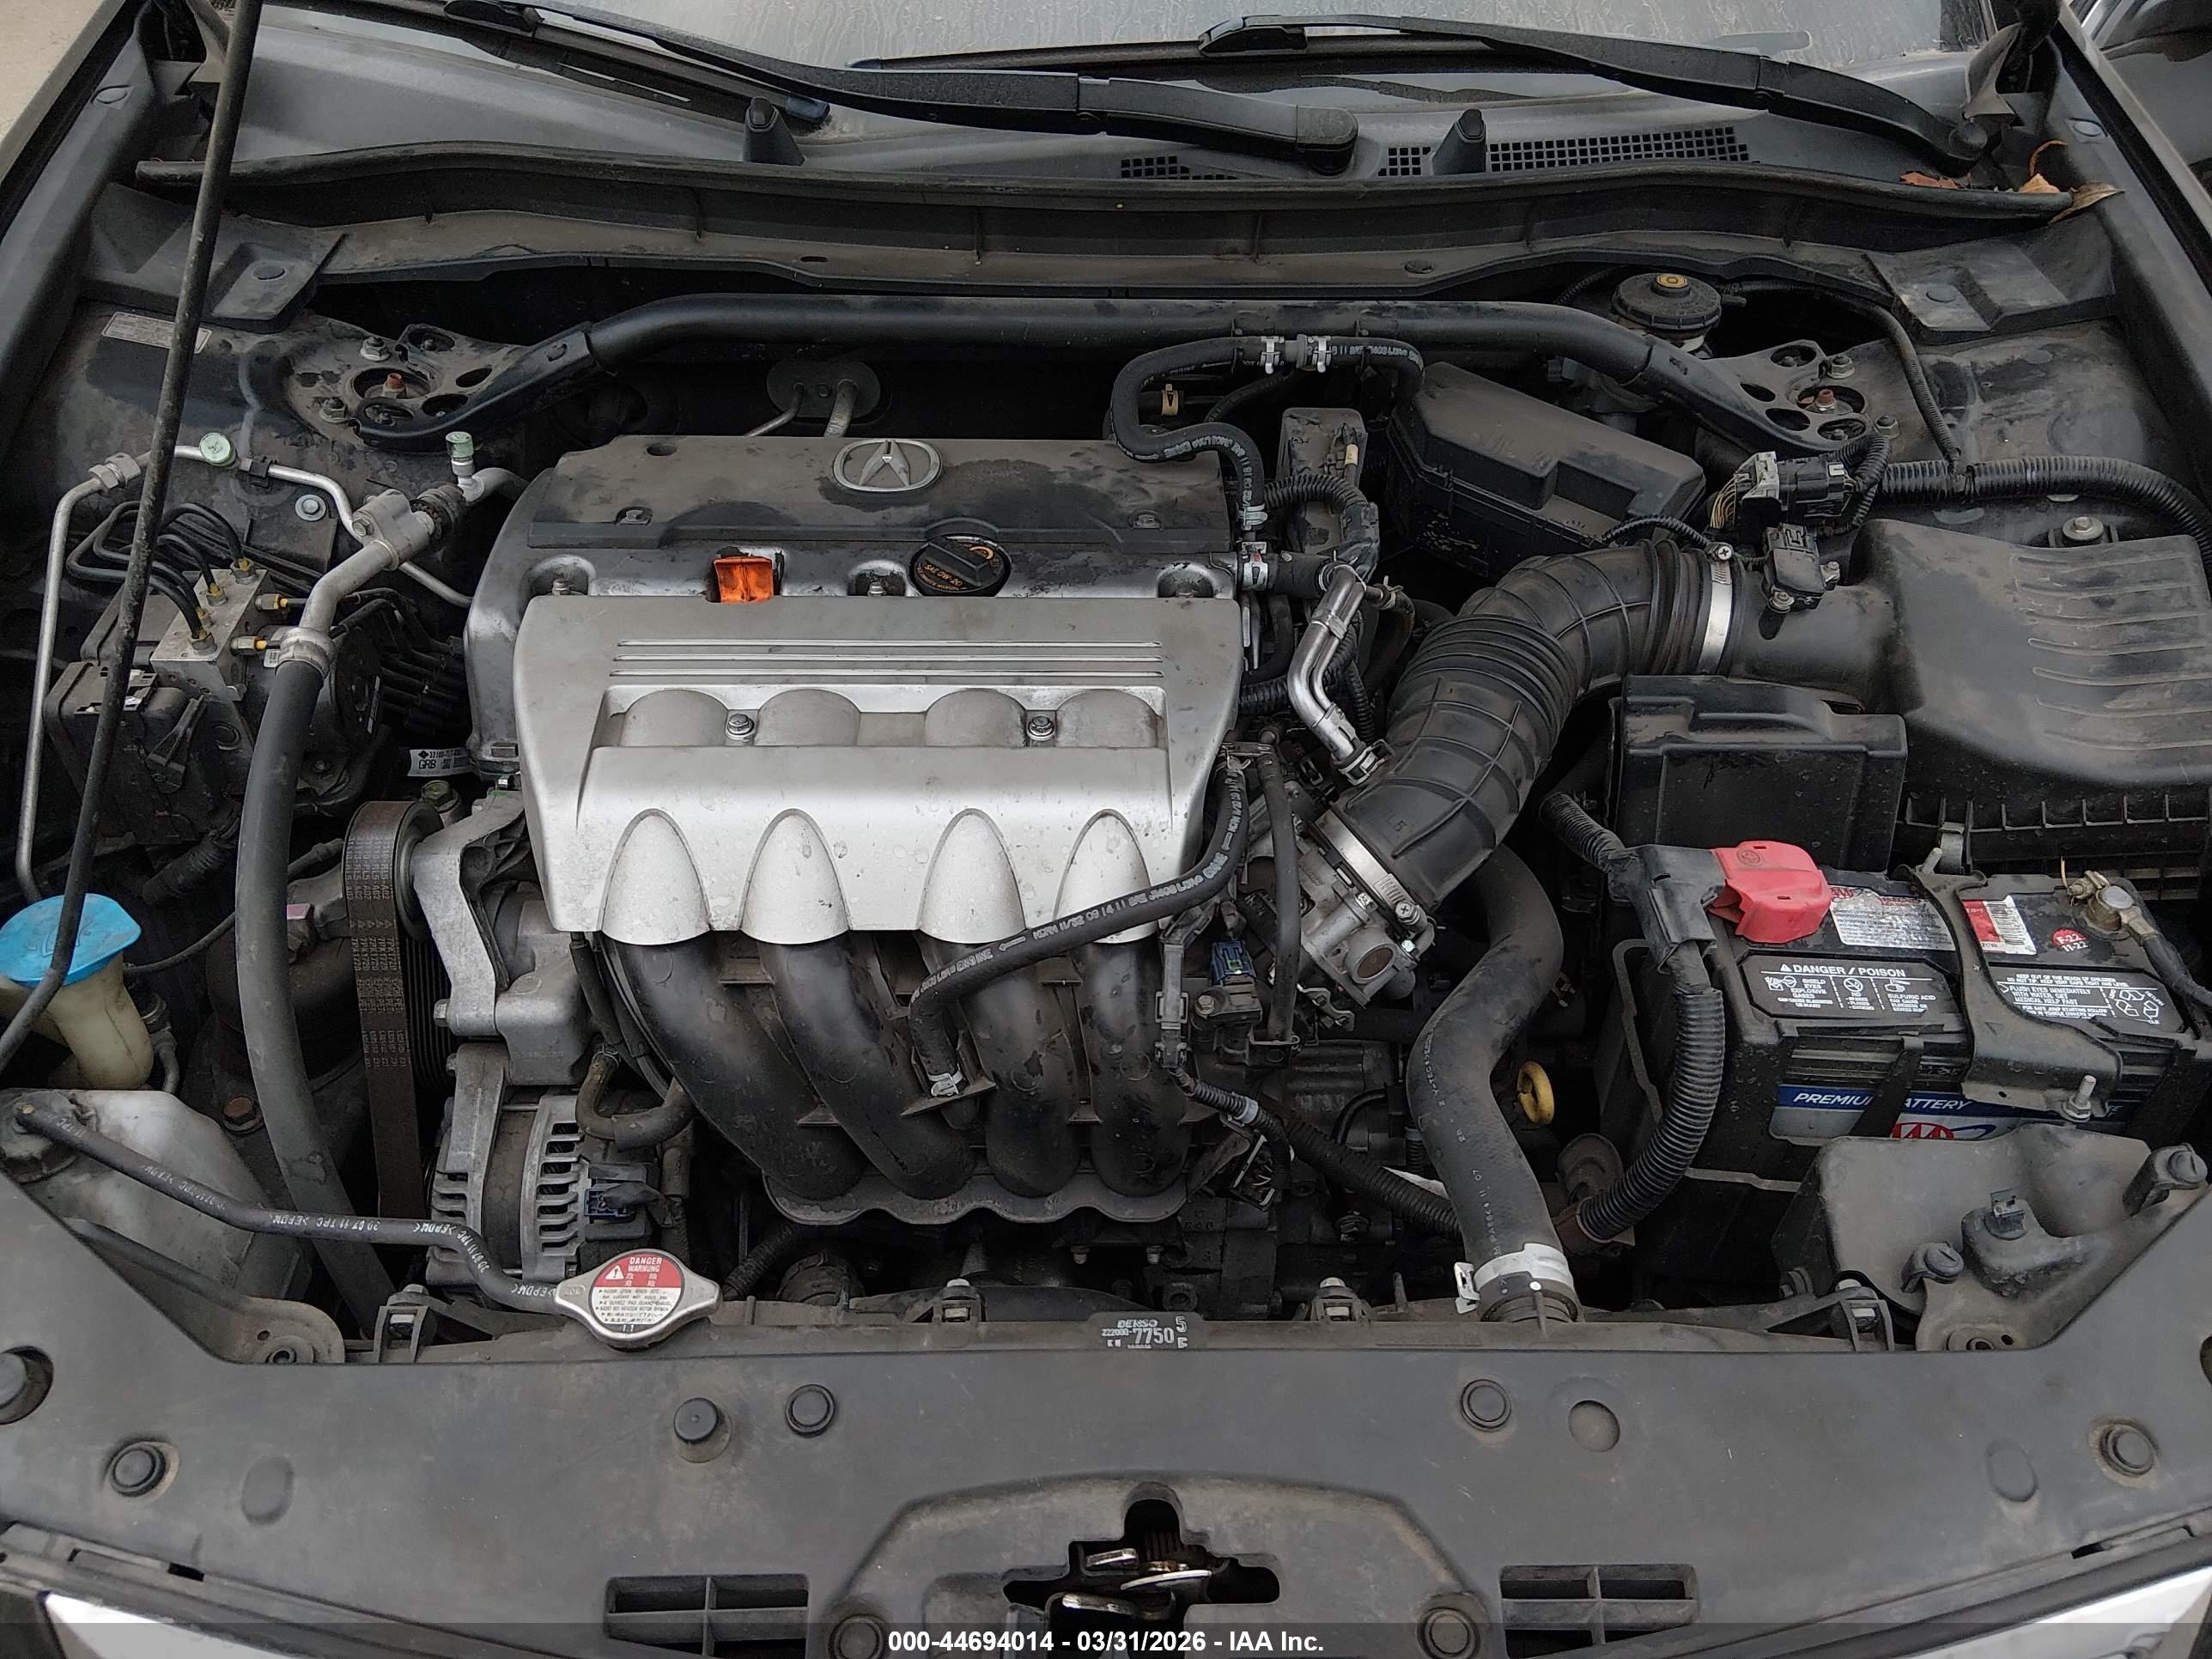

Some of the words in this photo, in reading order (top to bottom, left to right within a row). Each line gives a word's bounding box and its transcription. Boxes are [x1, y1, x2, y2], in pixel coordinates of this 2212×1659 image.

[1793, 963, 1846, 975] DANGER
[1859, 967, 1906, 977] POISON
[1904, 1098, 1972, 1110] ATTERY
[629, 1256, 662, 1265] DANGER
[1117, 1319, 1158, 1328] DENSO
[1175, 1316, 1188, 1333] 5
